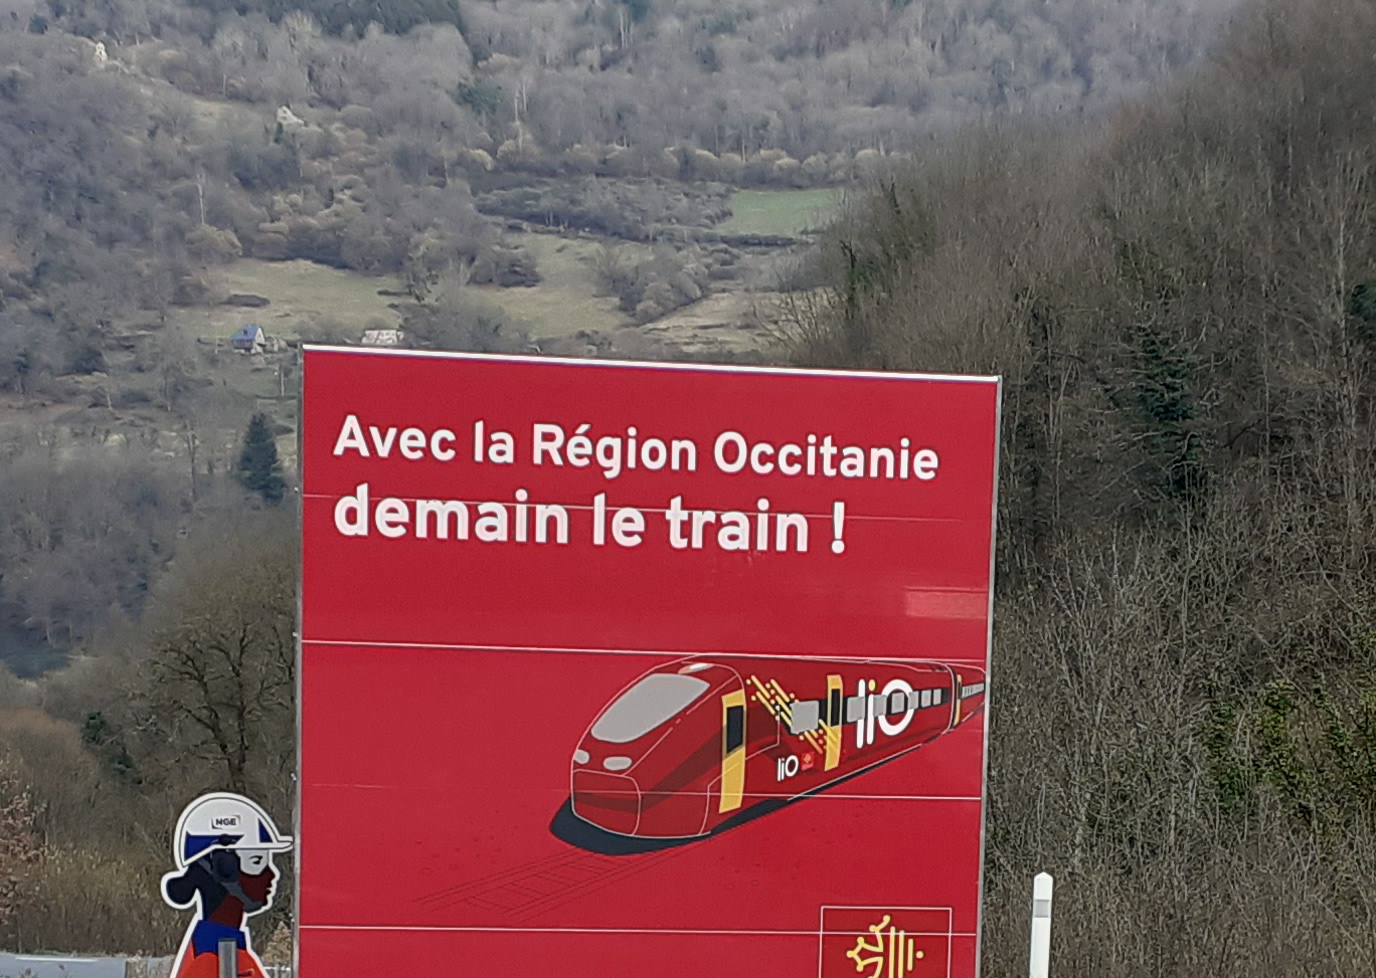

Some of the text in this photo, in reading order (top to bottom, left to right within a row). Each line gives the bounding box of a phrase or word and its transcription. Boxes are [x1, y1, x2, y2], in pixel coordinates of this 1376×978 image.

[333, 414, 939, 480] Avec la Région Occitanie
[334, 482, 845, 554] demain le train !
